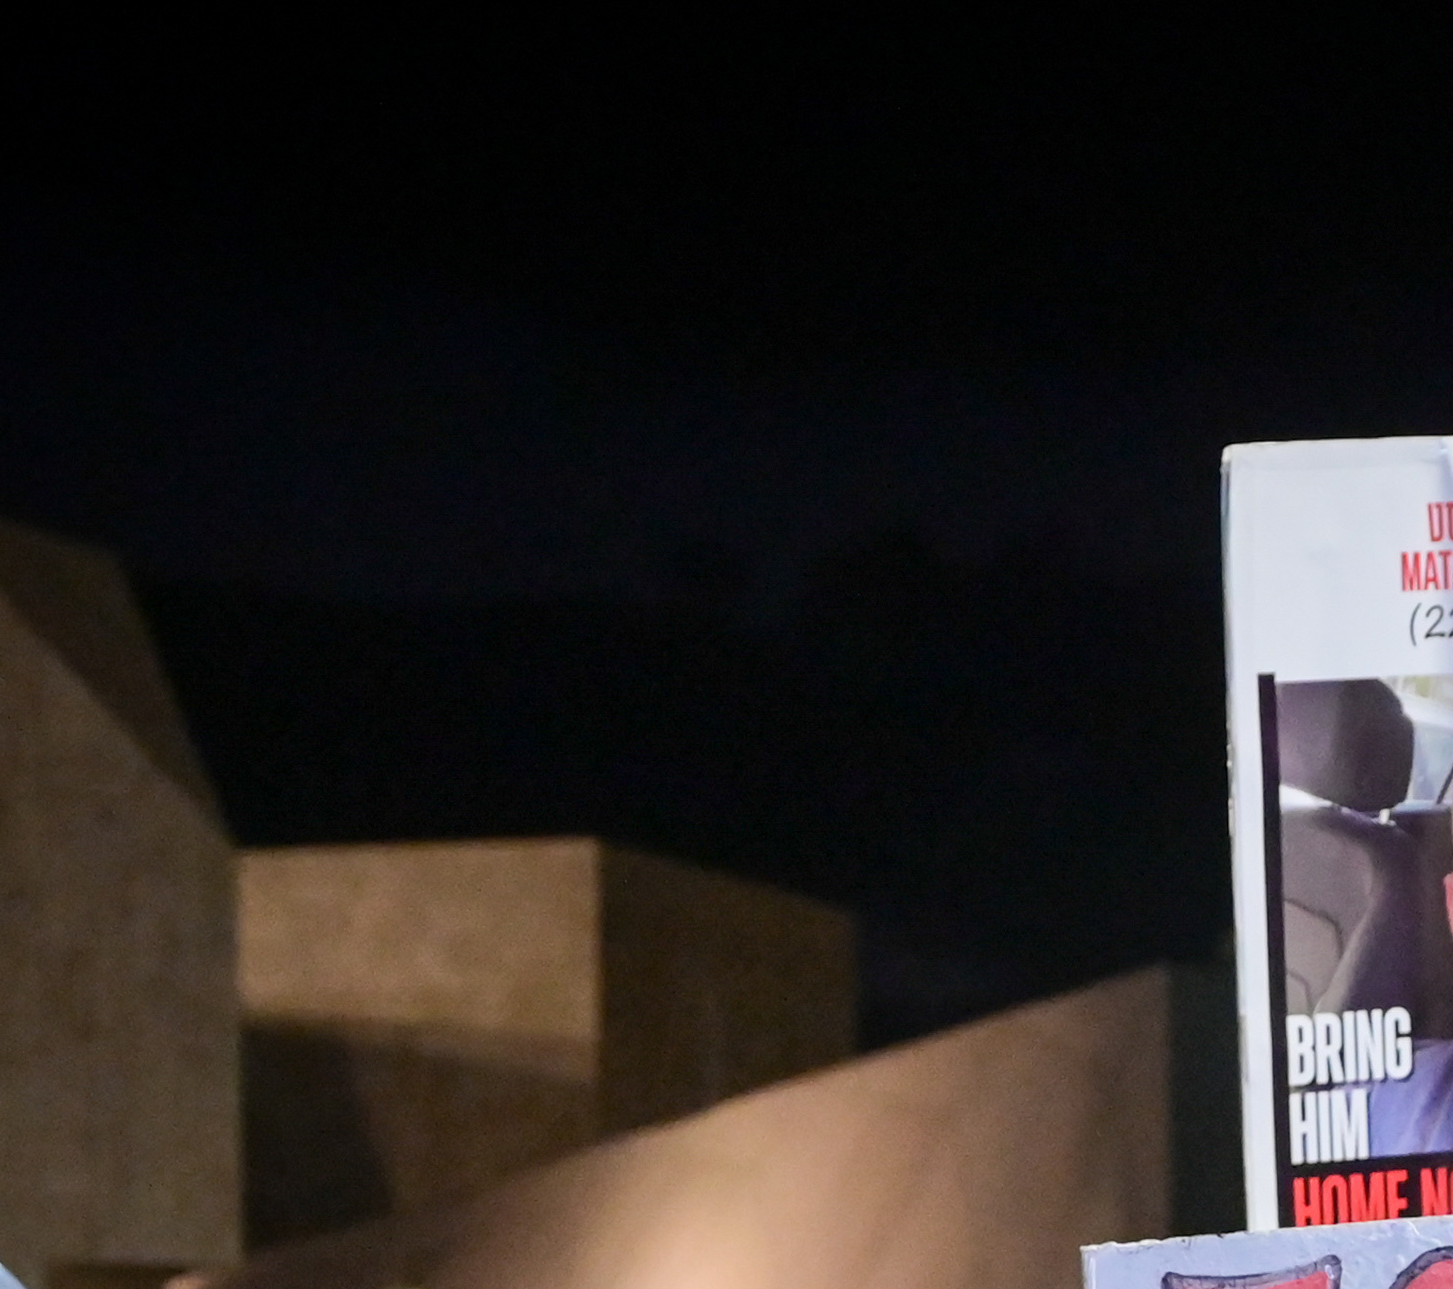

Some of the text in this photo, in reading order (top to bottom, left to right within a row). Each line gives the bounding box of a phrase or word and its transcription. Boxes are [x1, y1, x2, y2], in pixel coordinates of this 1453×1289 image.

[1286, 1007, 1413, 1087] BRING
[1289, 1088, 1370, 1166] HIM
[1292, 1168, 1409, 1228] HOME
